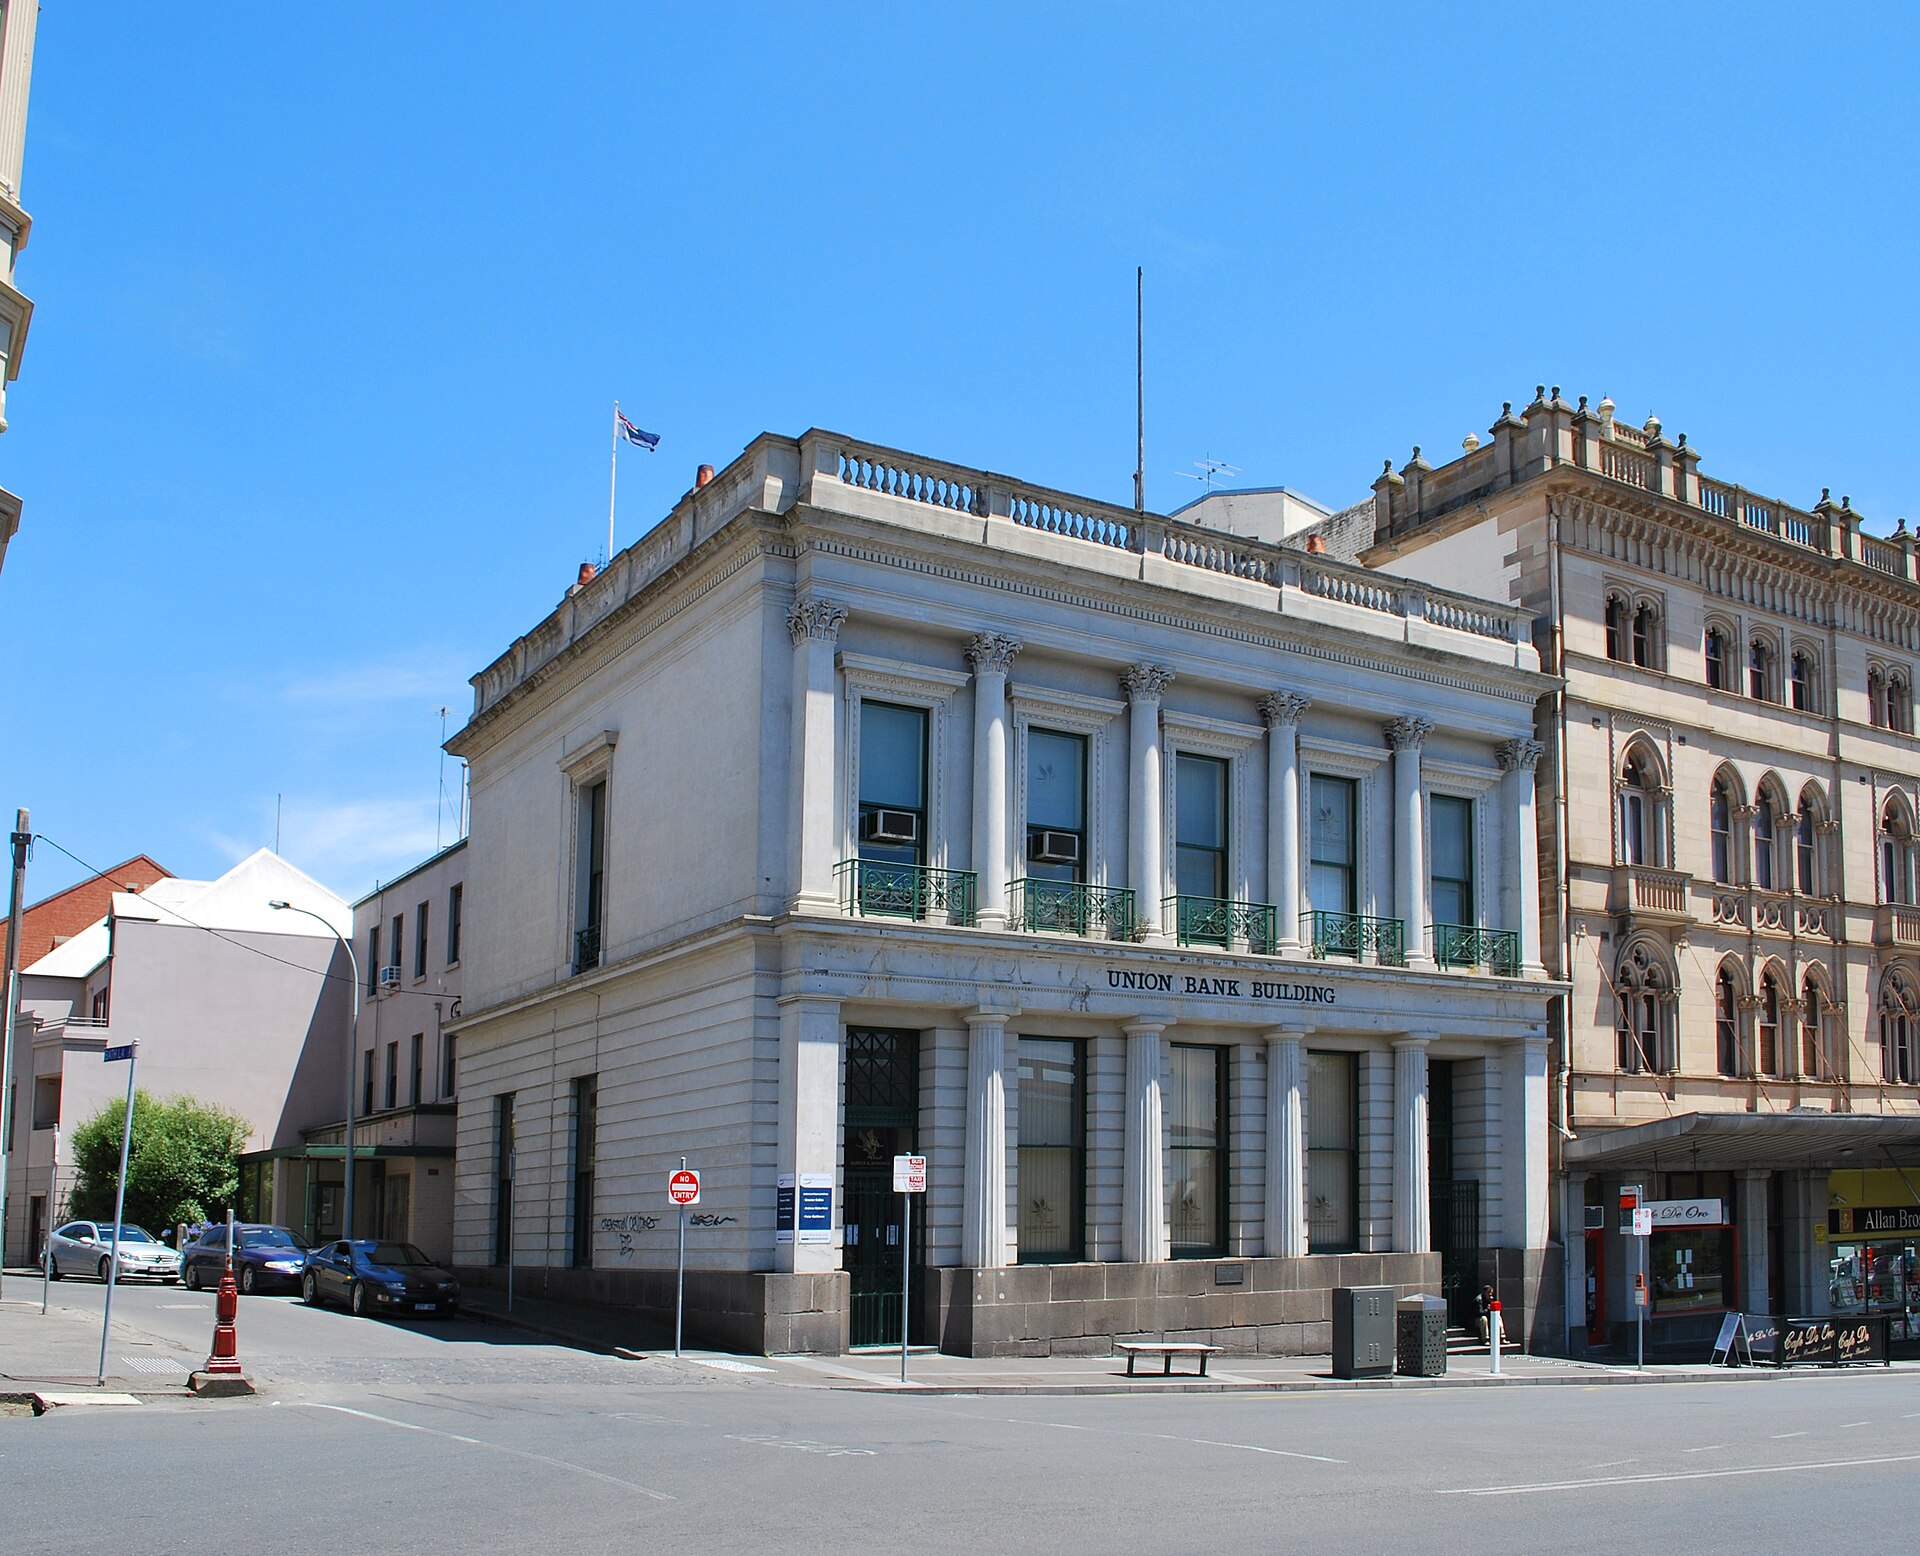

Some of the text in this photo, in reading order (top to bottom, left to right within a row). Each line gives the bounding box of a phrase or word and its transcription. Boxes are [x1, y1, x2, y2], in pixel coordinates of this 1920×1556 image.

[1106, 970, 1336, 1003] UNION BANK BUILDING
[679, 1175, 690, 1183] NO
[673, 1191, 694, 1199] ENTRY
[1660, 1206, 1683, 1219] De
[1685, 1206, 1708, 1219] Oro
[1865, 1209, 1920, 1229] Allan Bro
